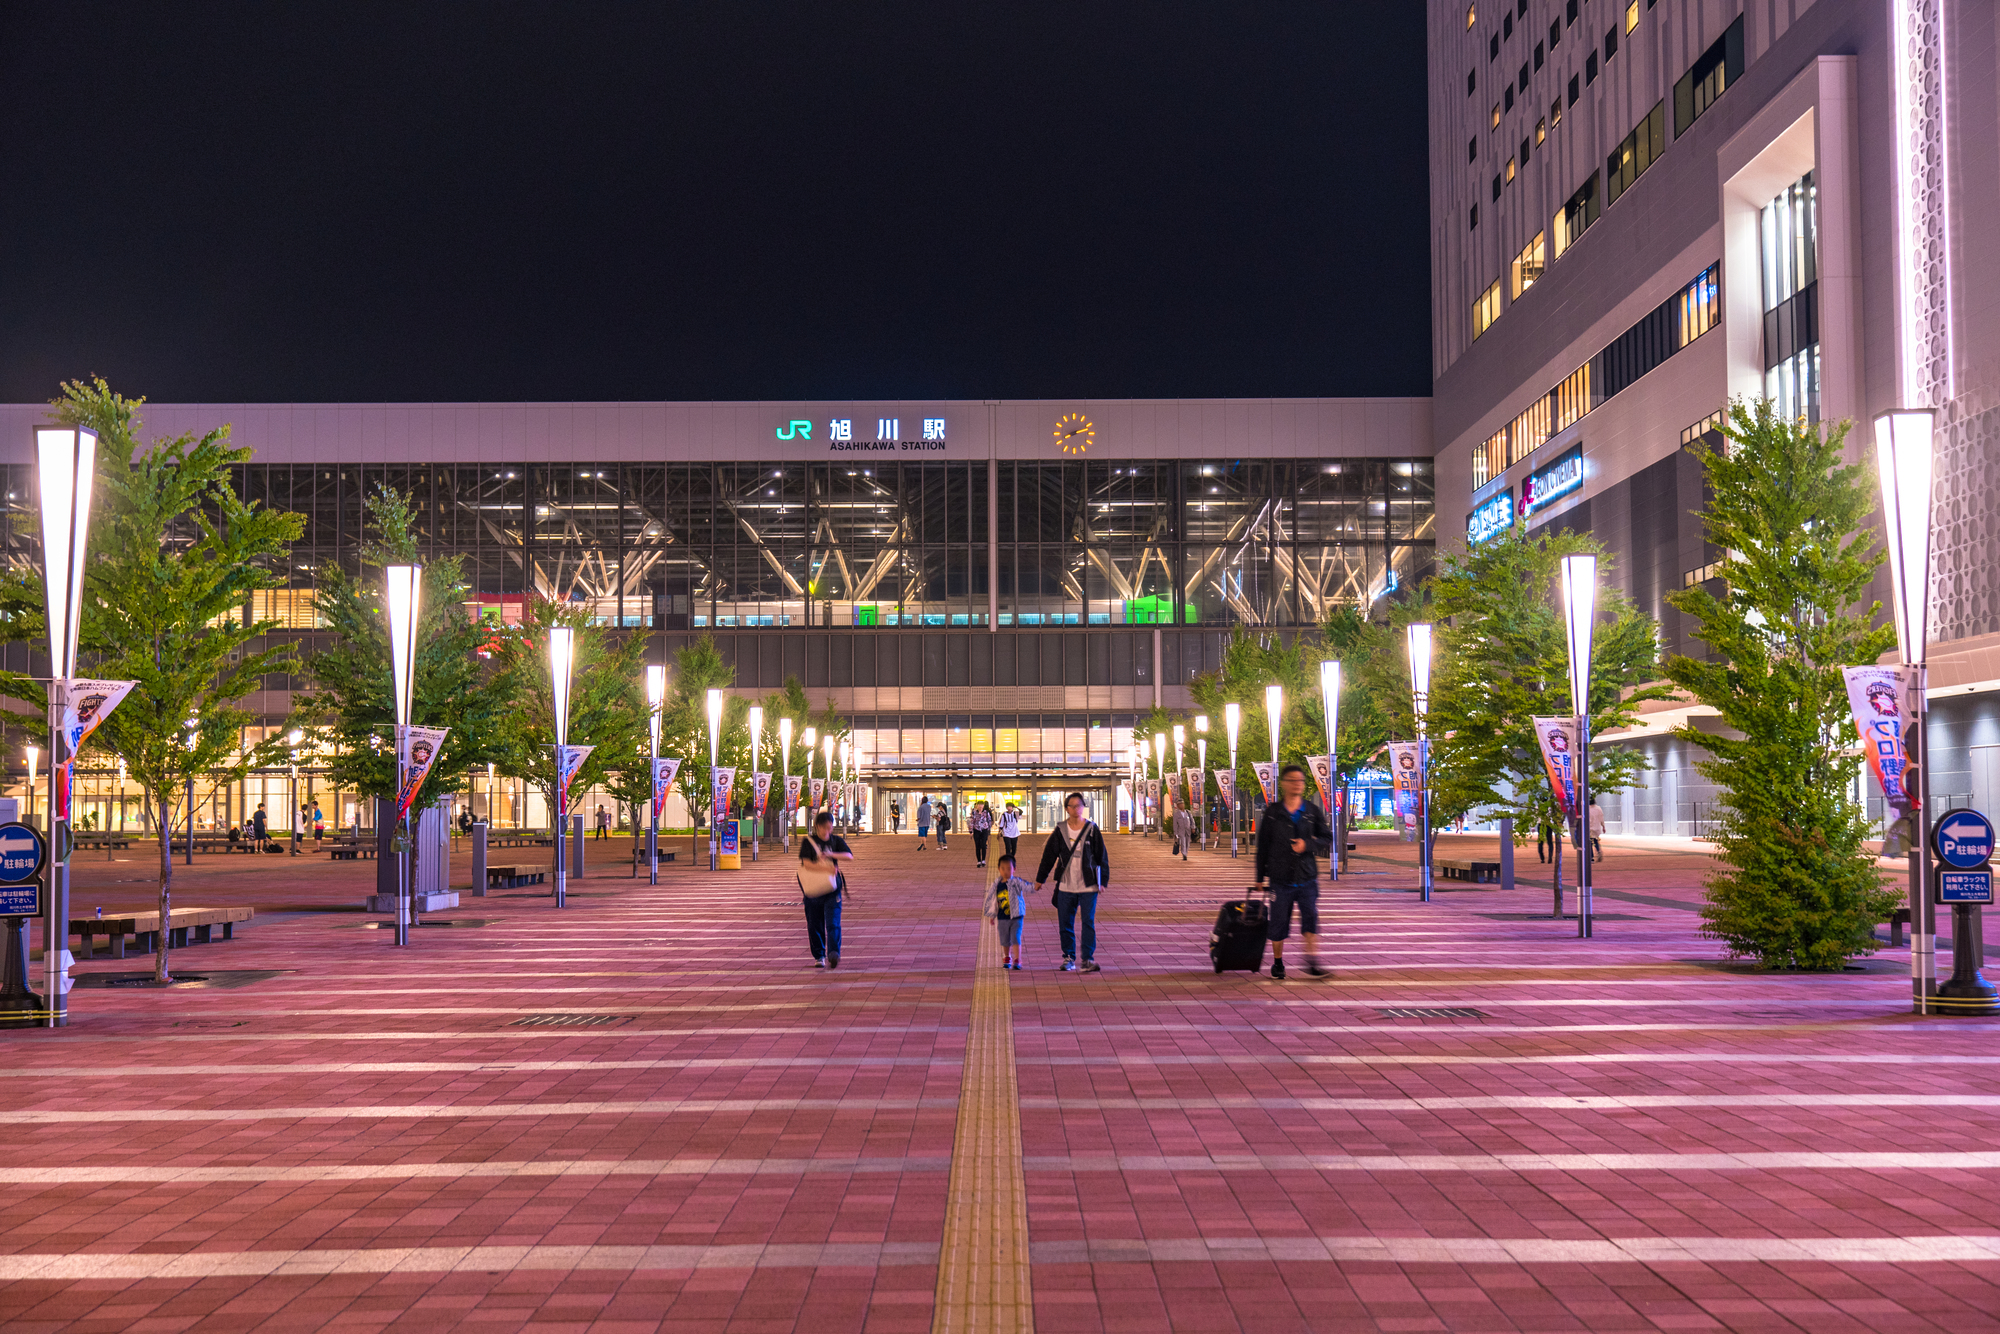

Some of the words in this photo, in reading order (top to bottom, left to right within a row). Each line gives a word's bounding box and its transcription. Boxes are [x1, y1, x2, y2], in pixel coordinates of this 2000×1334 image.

[776, 419, 812, 440] JR
[830, 441, 895, 450] ASAHIKAWA
[901, 441, 946, 450] STATION
[1944, 840, 1955, 855] P
[1956, 845, 1987, 856] 駐輪場
[4, 858, 34, 869] 駐輪場
